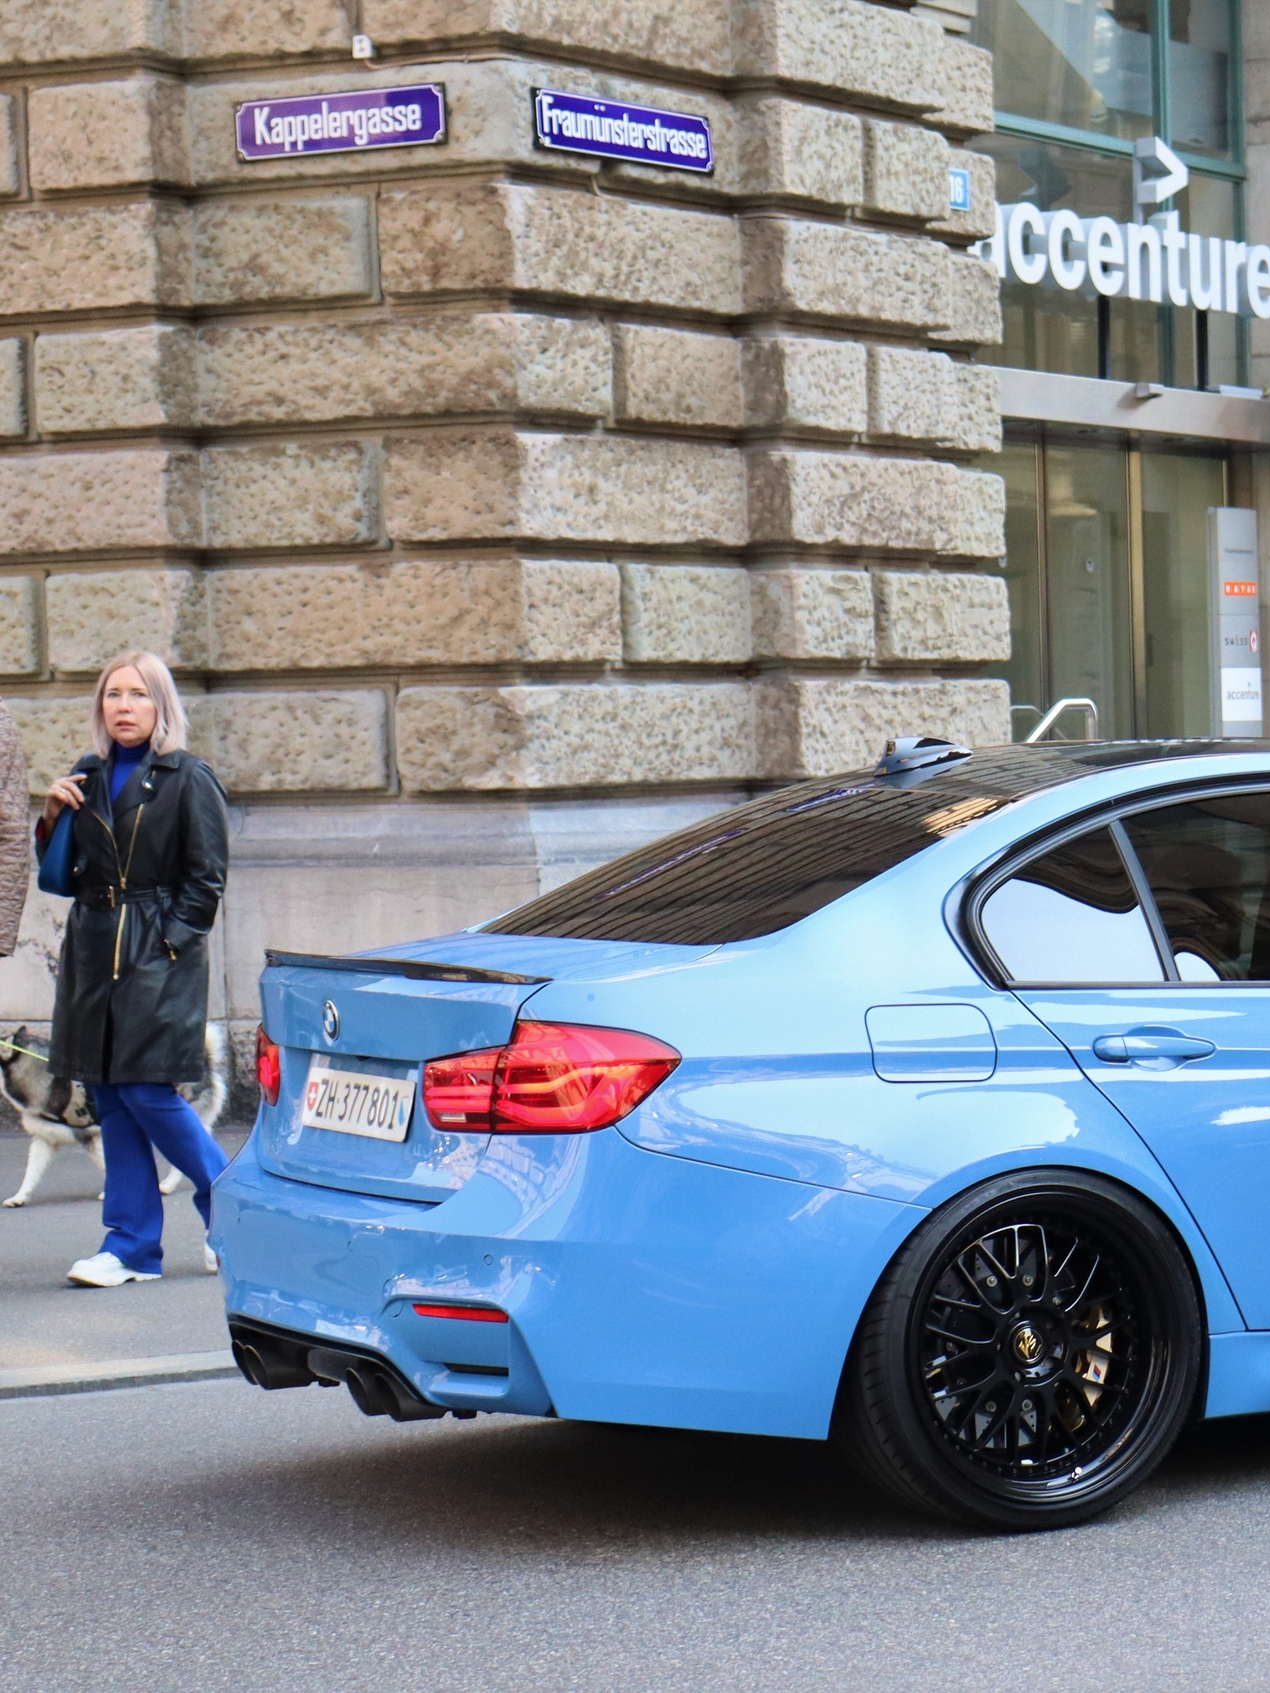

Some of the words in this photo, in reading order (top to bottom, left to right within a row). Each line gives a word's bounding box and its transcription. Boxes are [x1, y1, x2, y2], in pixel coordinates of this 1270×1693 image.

[254, 101, 421, 152] Kappelergasse
[542, 96, 707, 159] Fraumünsterstrasse
[1226, 689, 1259, 700] accenture
